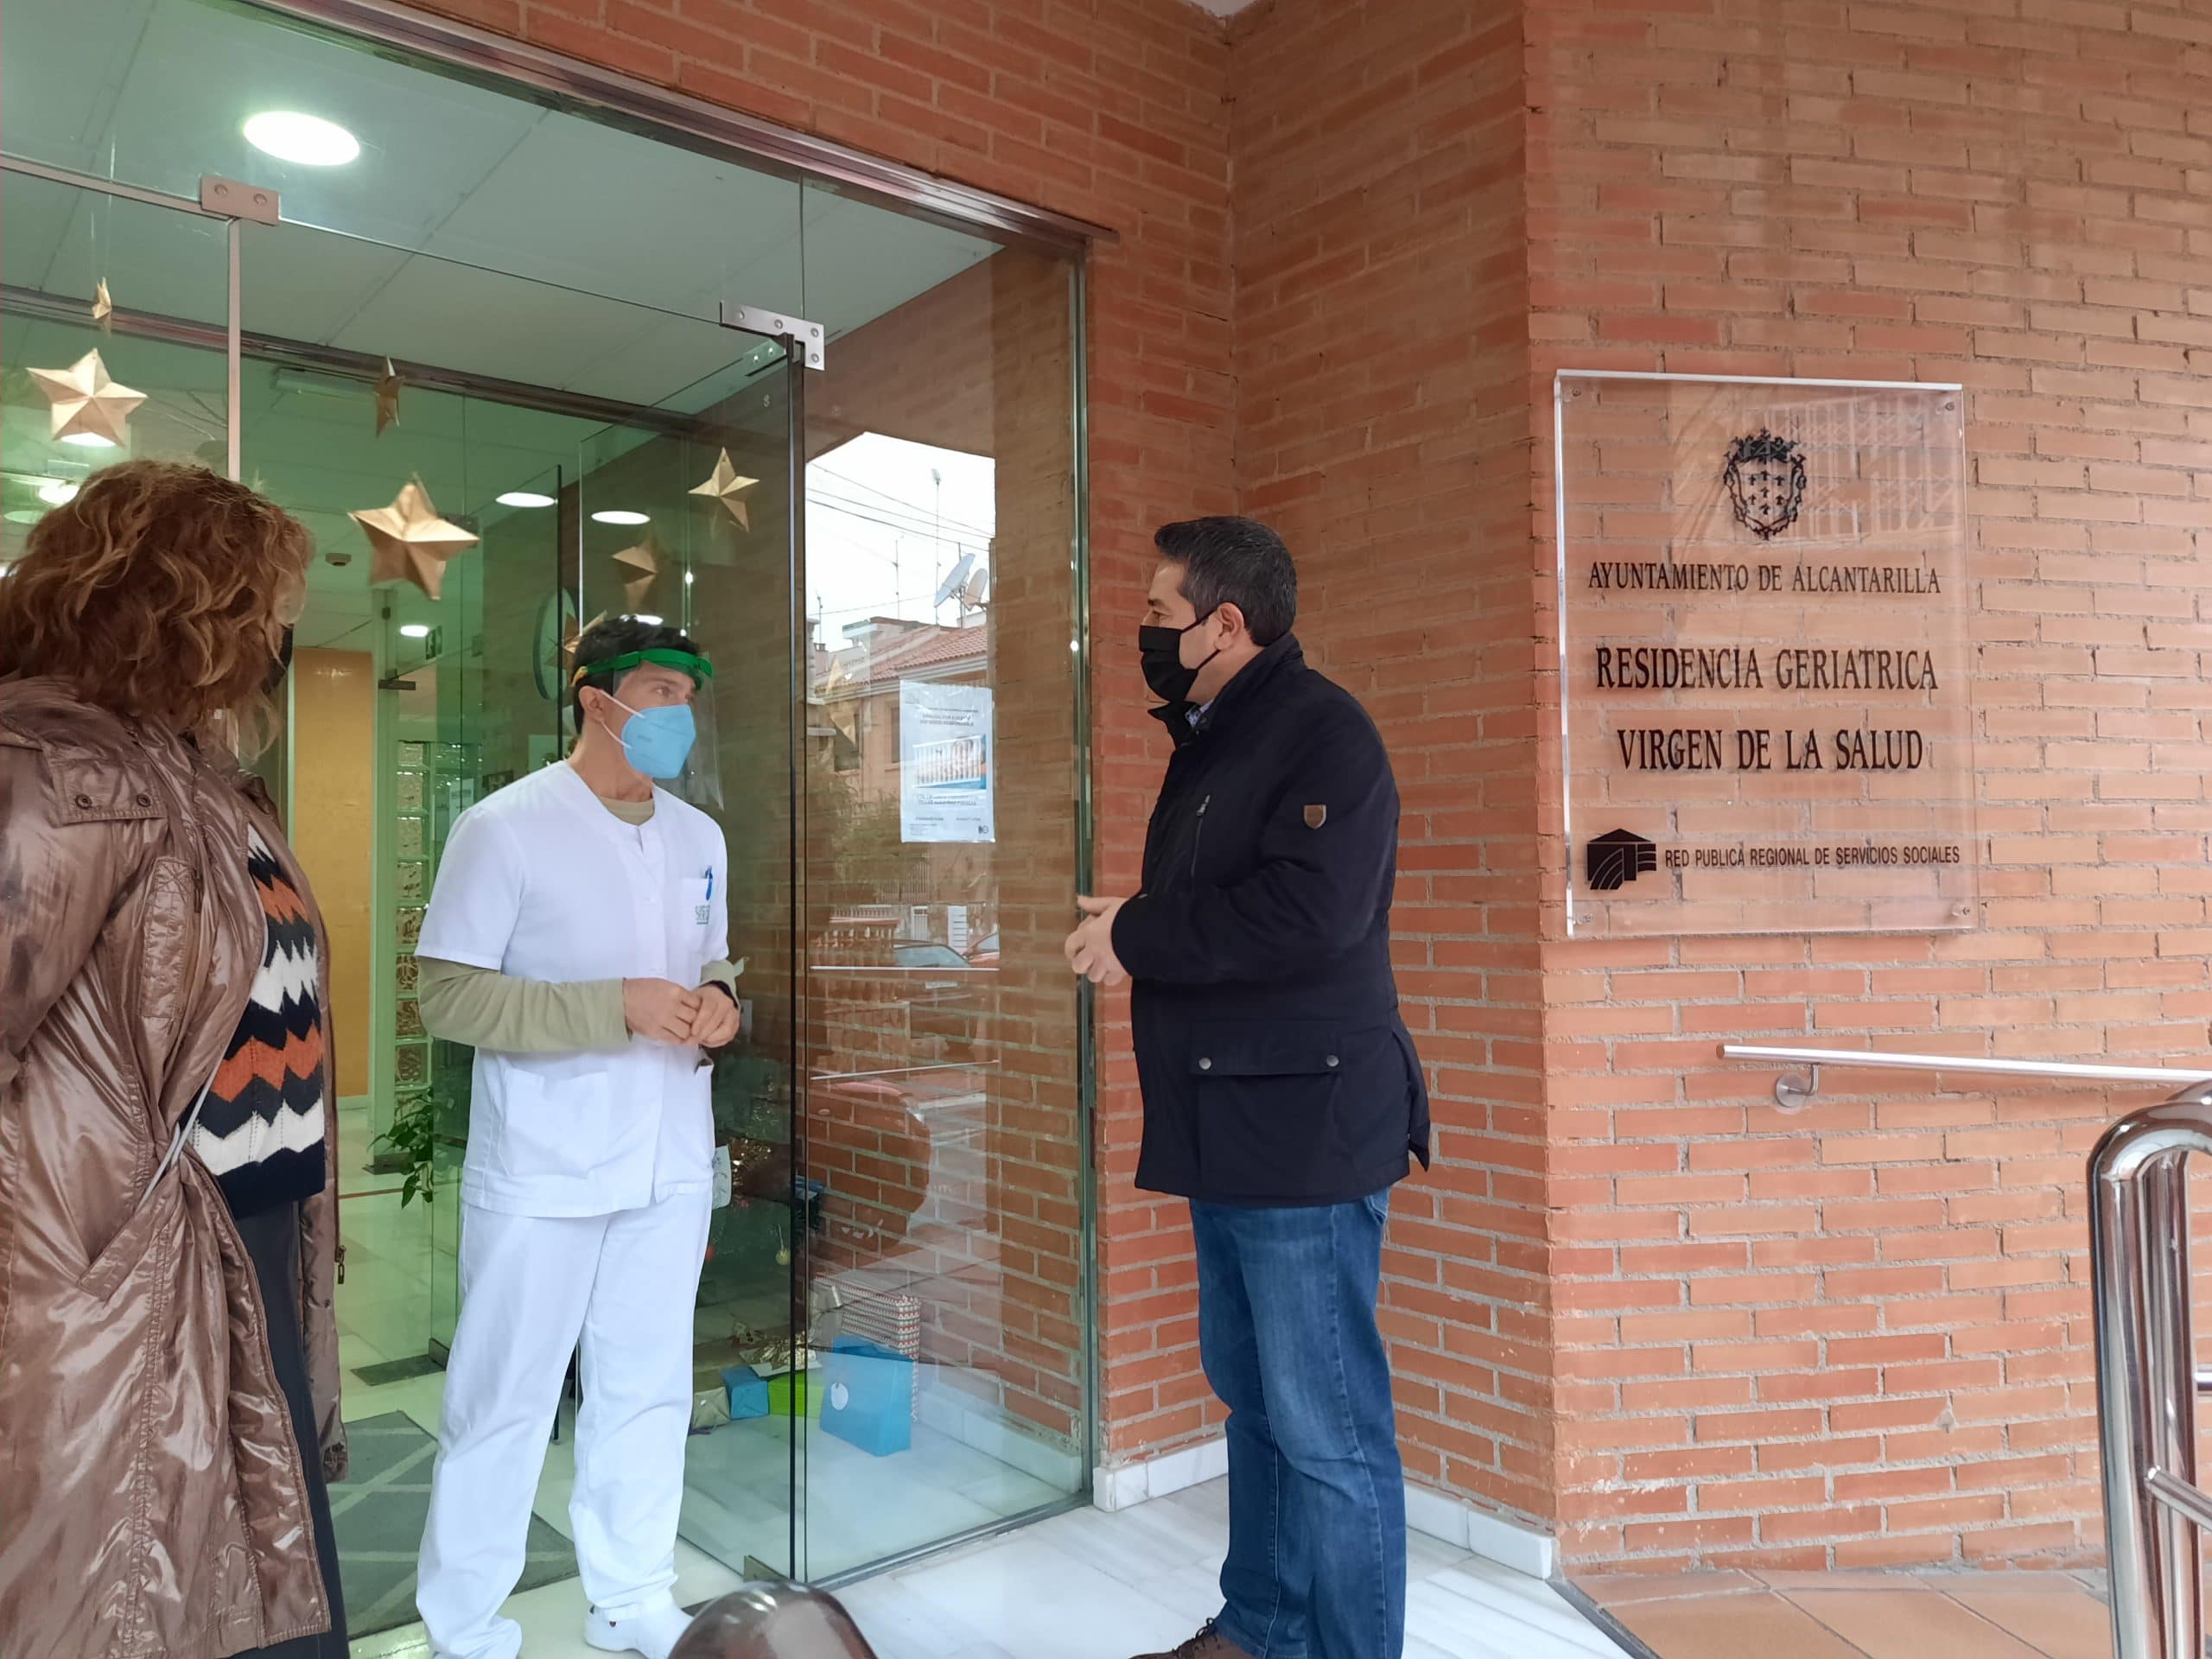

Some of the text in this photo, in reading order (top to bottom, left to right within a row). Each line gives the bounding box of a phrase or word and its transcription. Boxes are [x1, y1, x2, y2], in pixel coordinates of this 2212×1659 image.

[1588, 562, 1942, 594] AYUNTAMIENTO DE ALCANTARILLA
[1596, 648, 1938, 690] RESIDENCIA GERIATRICA
[1618, 728, 1923, 770] VIRGEN DE LA SALUD
[1665, 849, 1689, 868] RED
[1750, 848, 1809, 866] REGIONAL
[1815, 848, 1829, 865] DE
[1835, 847, 1897, 865] SERVICIOS
[1904, 846, 1960, 864] SOCIALES
